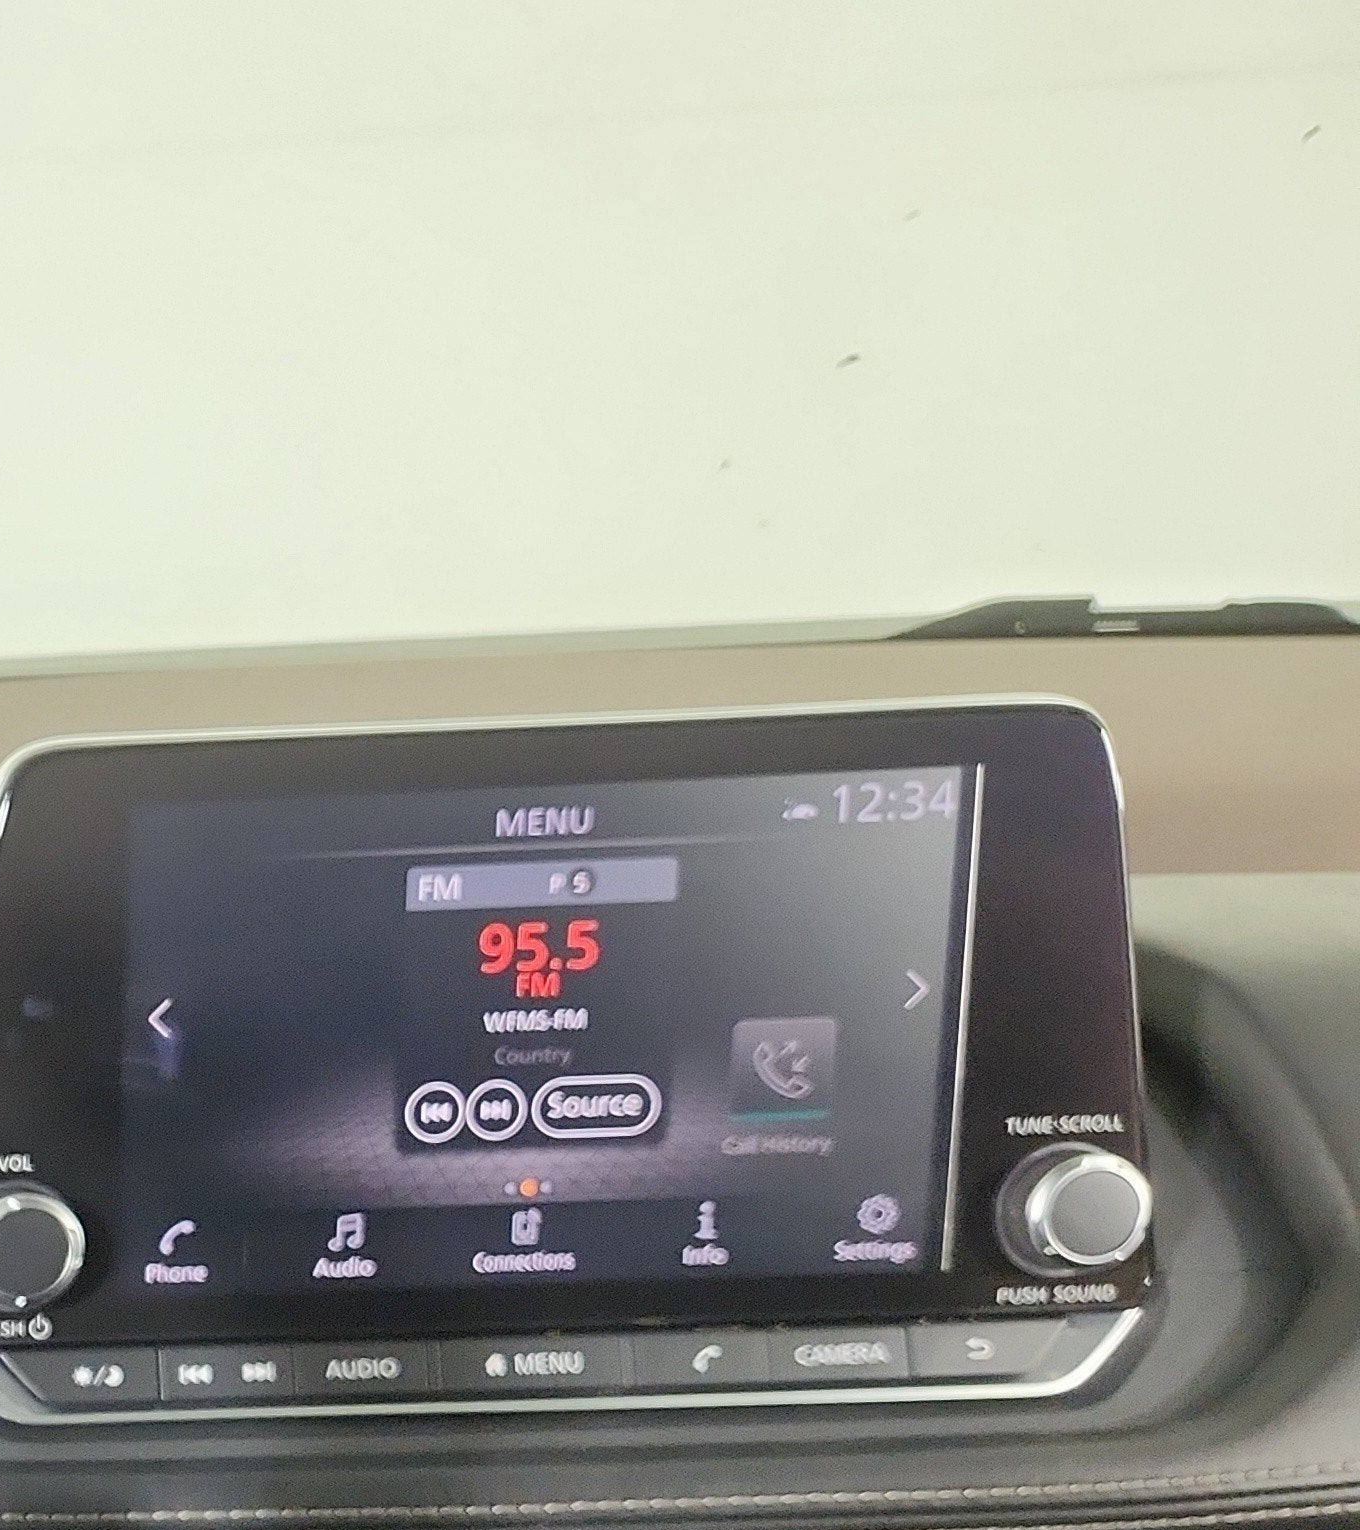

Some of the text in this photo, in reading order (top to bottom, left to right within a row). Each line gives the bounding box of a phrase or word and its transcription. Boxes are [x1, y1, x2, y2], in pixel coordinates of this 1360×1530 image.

[832, 779, 956, 825] 12:34
[494, 805, 595, 838] MENU
[417, 873, 463, 901] FM
[479, 919, 601, 974] 95.5
[515, 972, 561, 998] FM
[483, 1007, 588, 1034] WFMS-FM
[493, 1045, 575, 1069] Country
[546, 1091, 643, 1120] Source
[720, 1135, 832, 1157] Call History
[472, 1250, 577, 1274] Connections
[681, 1243, 730, 1267] Info
[833, 1239, 919, 1264] Settings
[144, 1263, 210, 1285] Phone
[312, 1256, 379, 1280] Audio
[996, 1283, 1117, 1306] PUSH SOUND
[513, 1351, 585, 1376] MENU
[794, 1341, 891, 1367] CAMERA
[325, 1356, 402, 1381] AUDIO
